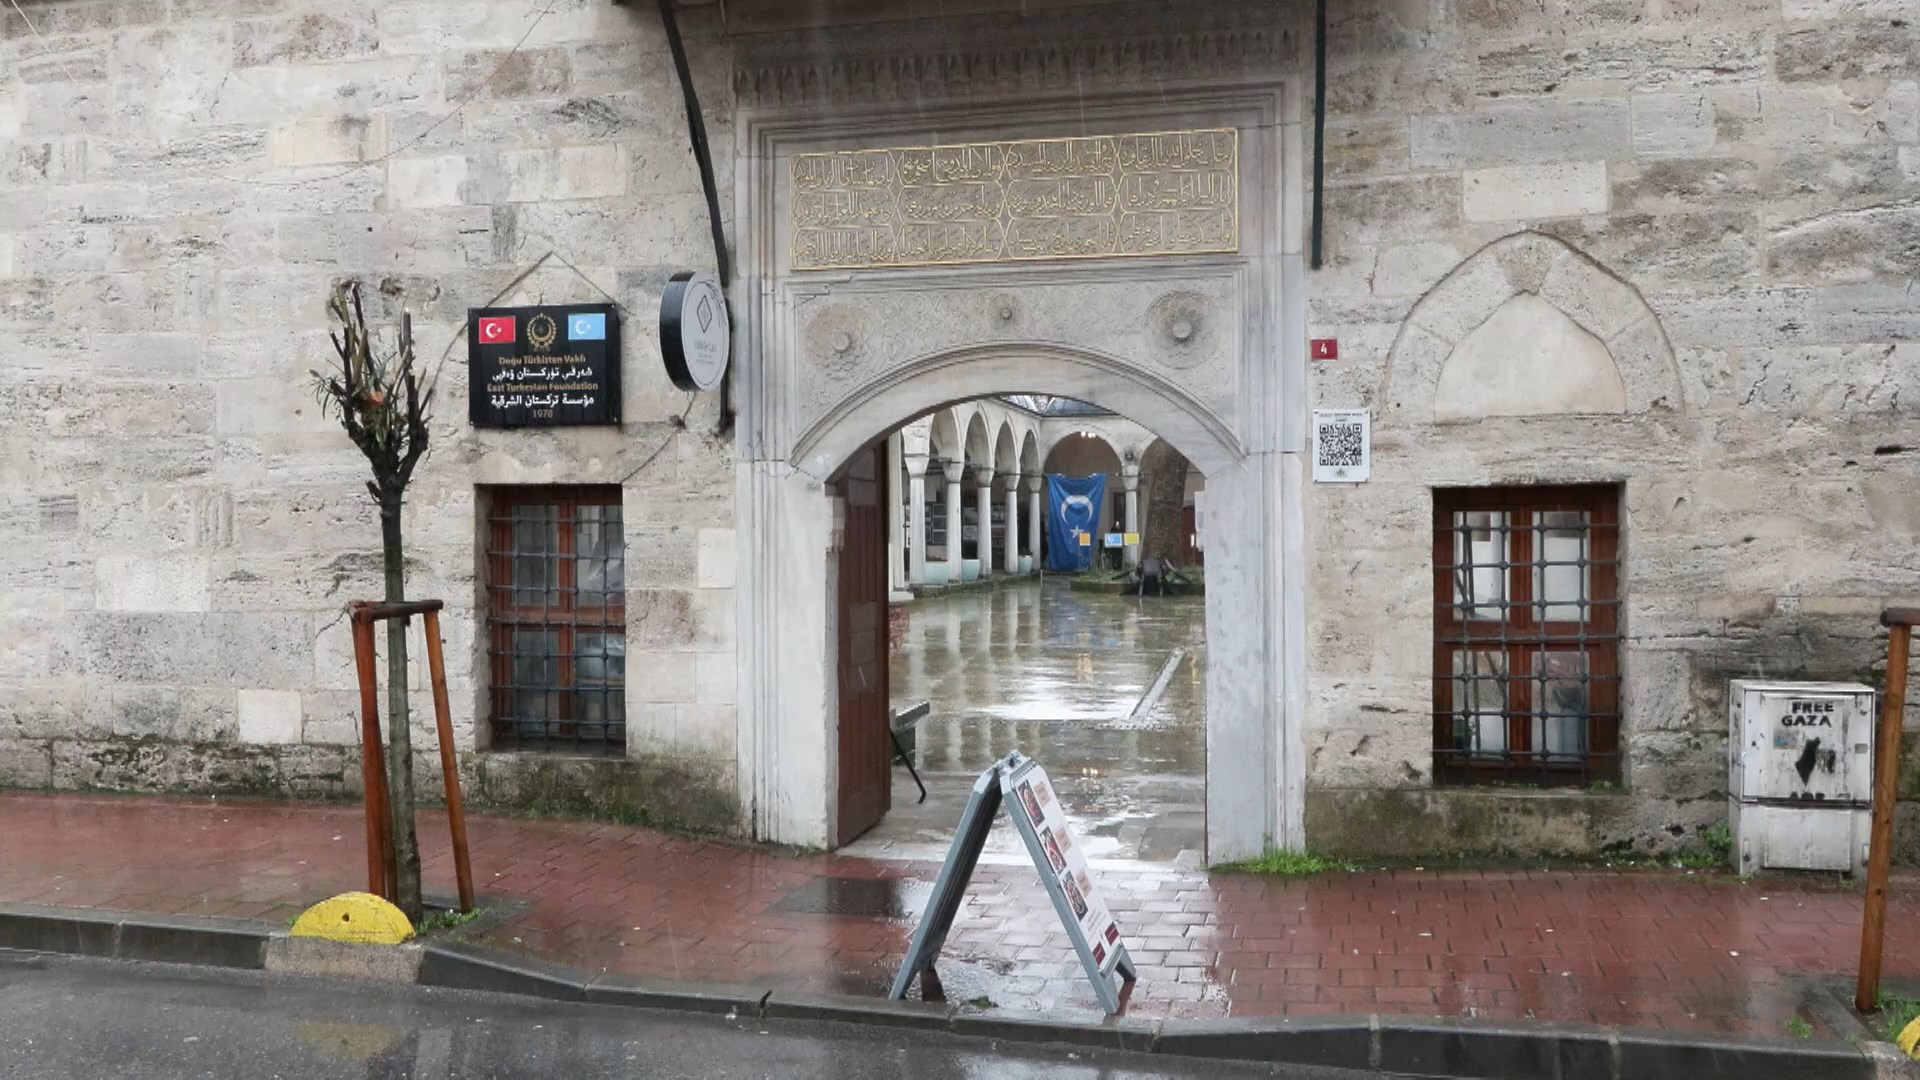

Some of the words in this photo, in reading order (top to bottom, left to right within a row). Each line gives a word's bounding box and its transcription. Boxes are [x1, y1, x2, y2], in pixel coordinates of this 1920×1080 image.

[1320, 343, 1327, 355] 4
[499, 356, 522, 366] Doğu
[524, 355, 562, 364] Türkistan
[564, 353, 586, 363] Vakfı
[487, 383, 505, 392] East
[506, 383, 547, 392] Turkestan
[549, 381, 598, 391] Foundation
[491, 394, 522, 409] الشرقية
[524, 393, 559, 408] تركستان
[562, 393, 594, 408] مؤسسة
[1792, 702, 1834, 714] FREE
[1781, 715, 1832, 728] GAZA
